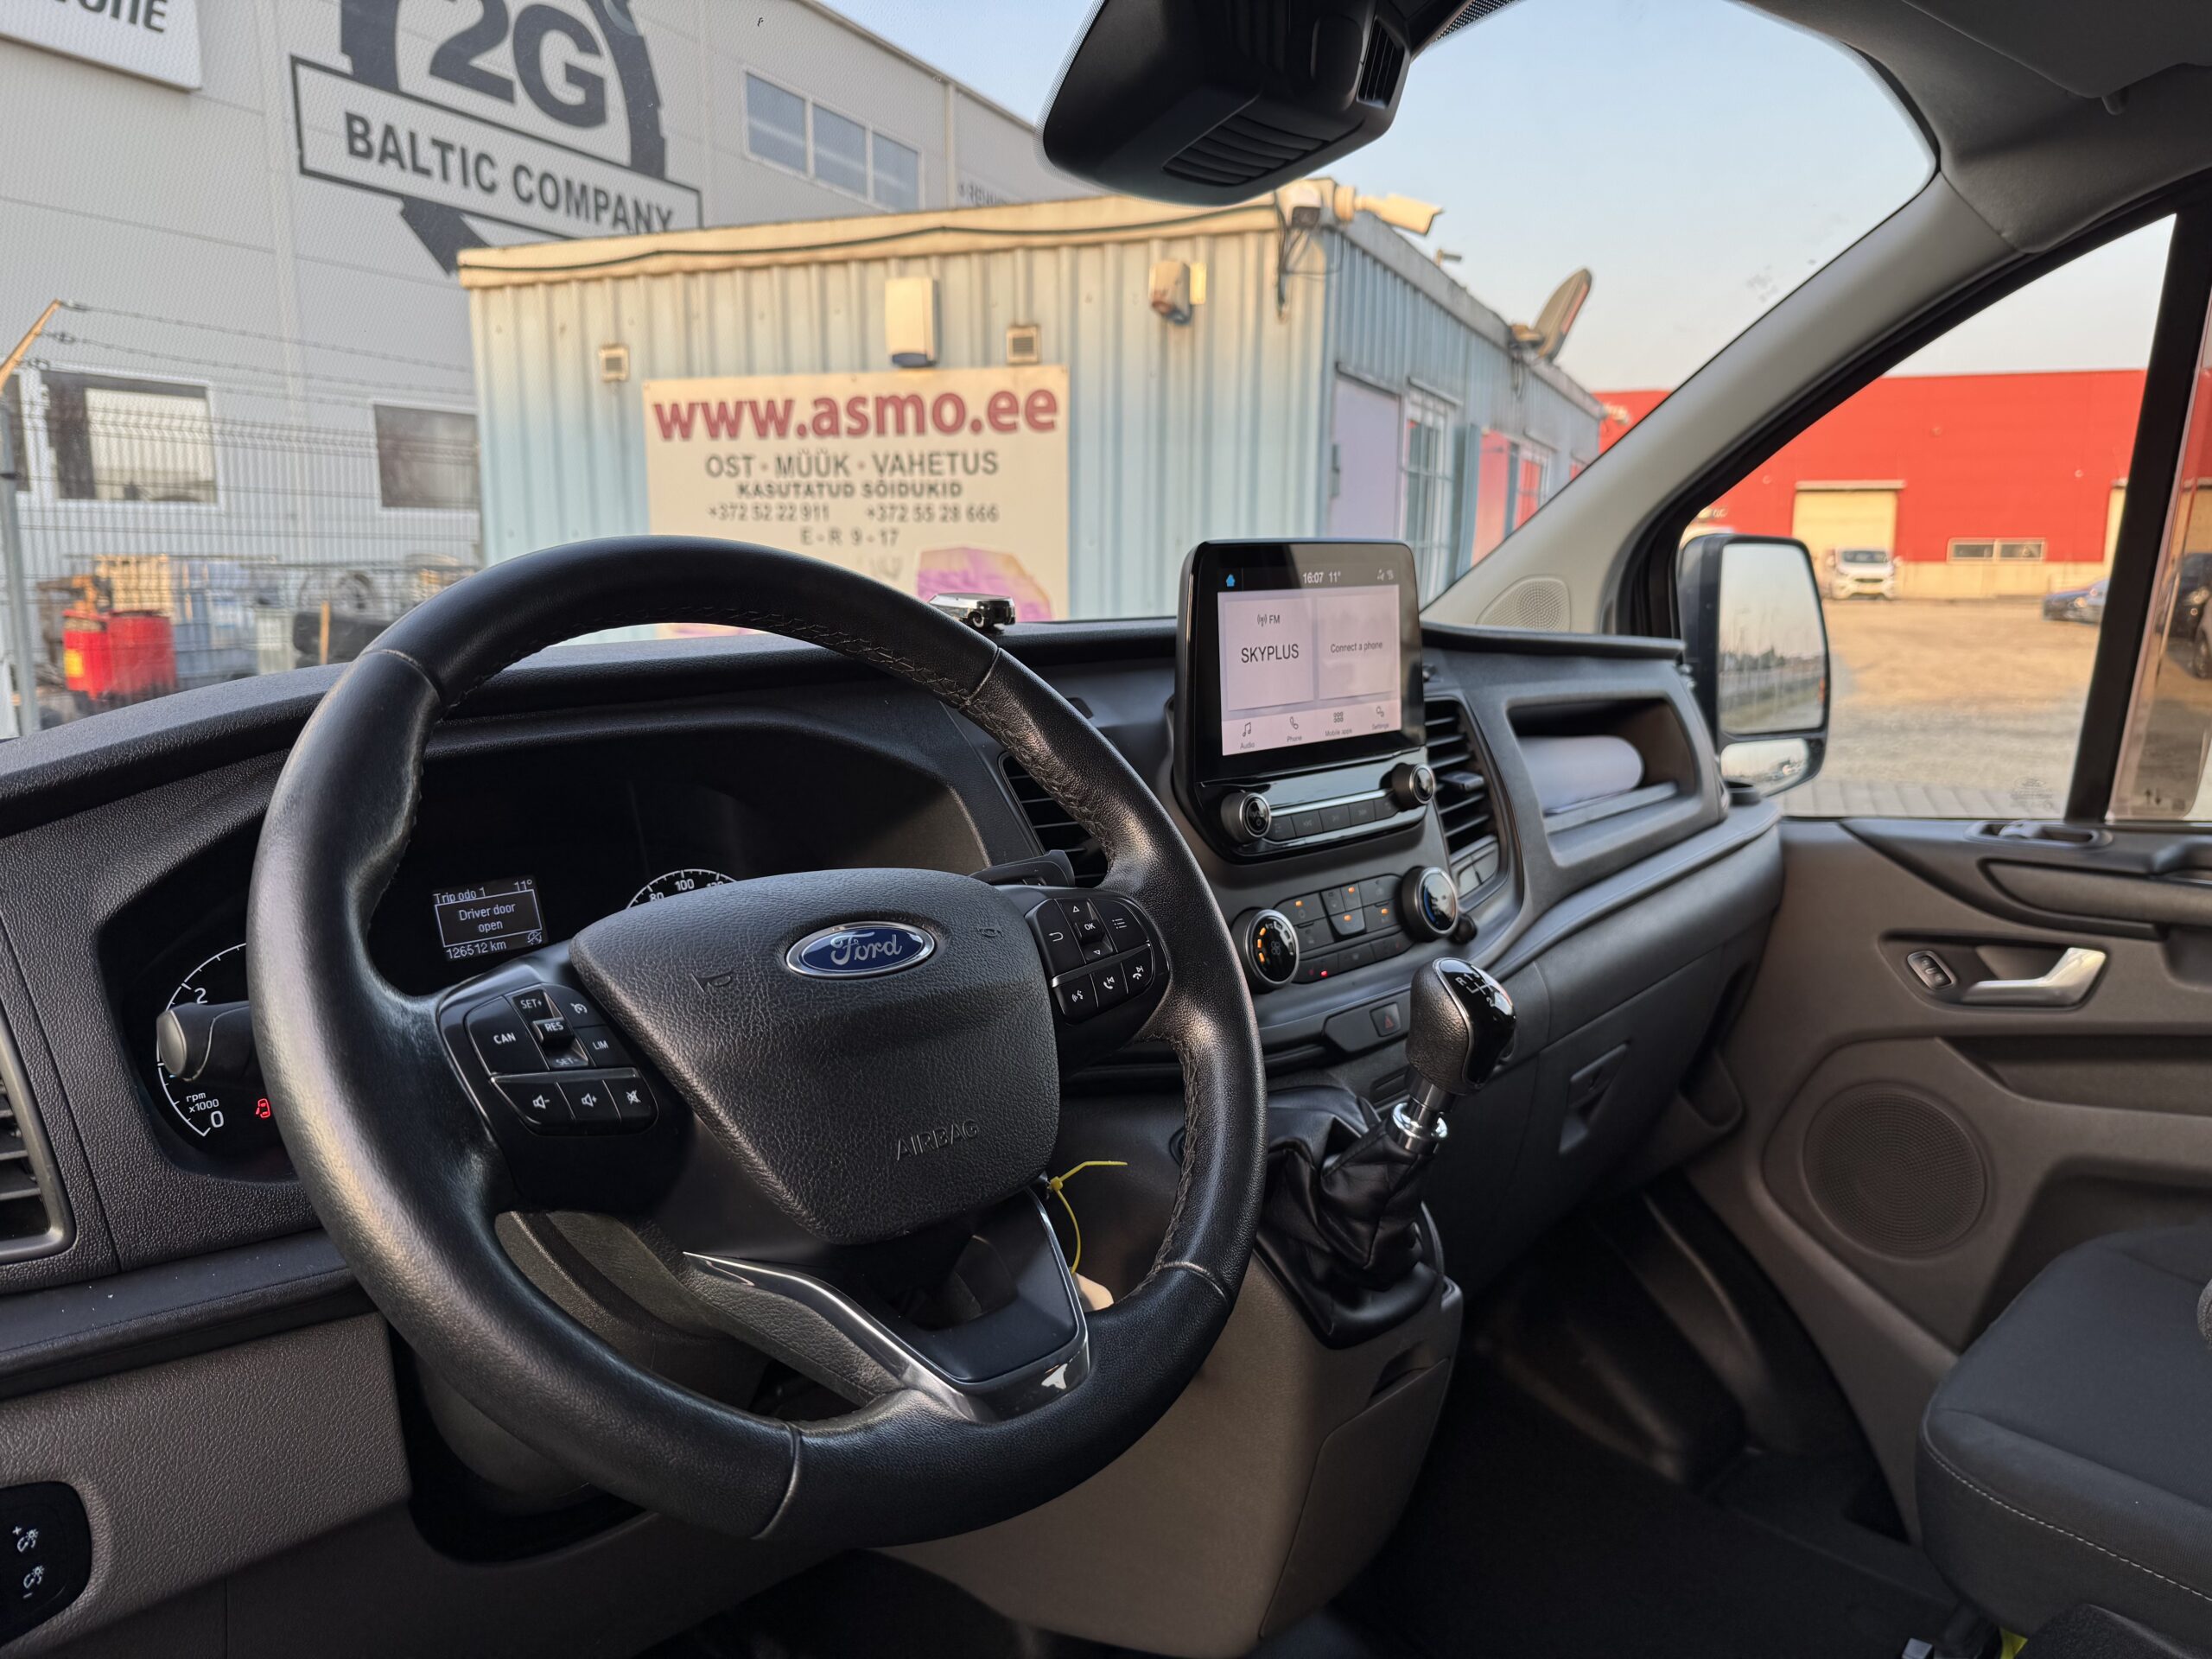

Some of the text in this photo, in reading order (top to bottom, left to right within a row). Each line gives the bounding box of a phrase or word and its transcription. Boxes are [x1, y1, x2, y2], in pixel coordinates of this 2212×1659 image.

[346, 111, 673, 233] BALTIC COMPANY
[654, 387, 1059, 441] www.asmo.ee
[705, 448, 999, 477] OST MÜÜK VAHETUS
[737, 480, 963, 499] KASUTATUD SÕIDUKID
[708, 505, 747, 521] +372
[778, 504, 798, 520] 22
[800, 503, 830, 520] 911
[1302, 571, 1324, 584] 16:07
[1268, 614, 1281, 625] FM
[1241, 643, 1300, 664] SKYPLUS
[1330, 643, 1357, 653] Connect
[1363, 640, 1382, 652] phone
[513, 879, 533, 892] 11°
[675, 878, 695, 891] 100
[433, 887, 486, 905] Trip odo 1
[459, 903, 516, 921] Driver door
[478, 920, 504, 933] open
[1084, 922, 1096, 931] OK
[446, 940, 507, 959] 126512 km
[830, 931, 903, 966] Ford
[1455, 976, 1467, 986] R
[194, 987, 208, 1004] 2
[544, 1021, 564, 1033] RES
[493, 1032, 517, 1045] CAN
[592, 1039, 609, 1051] LIM
[186, 1091, 207, 1103] rpm
[188, 1098, 219, 1113] x1000
[210, 1110, 225, 1128] 0
[896, 1119, 978, 1160] AIRBAG
